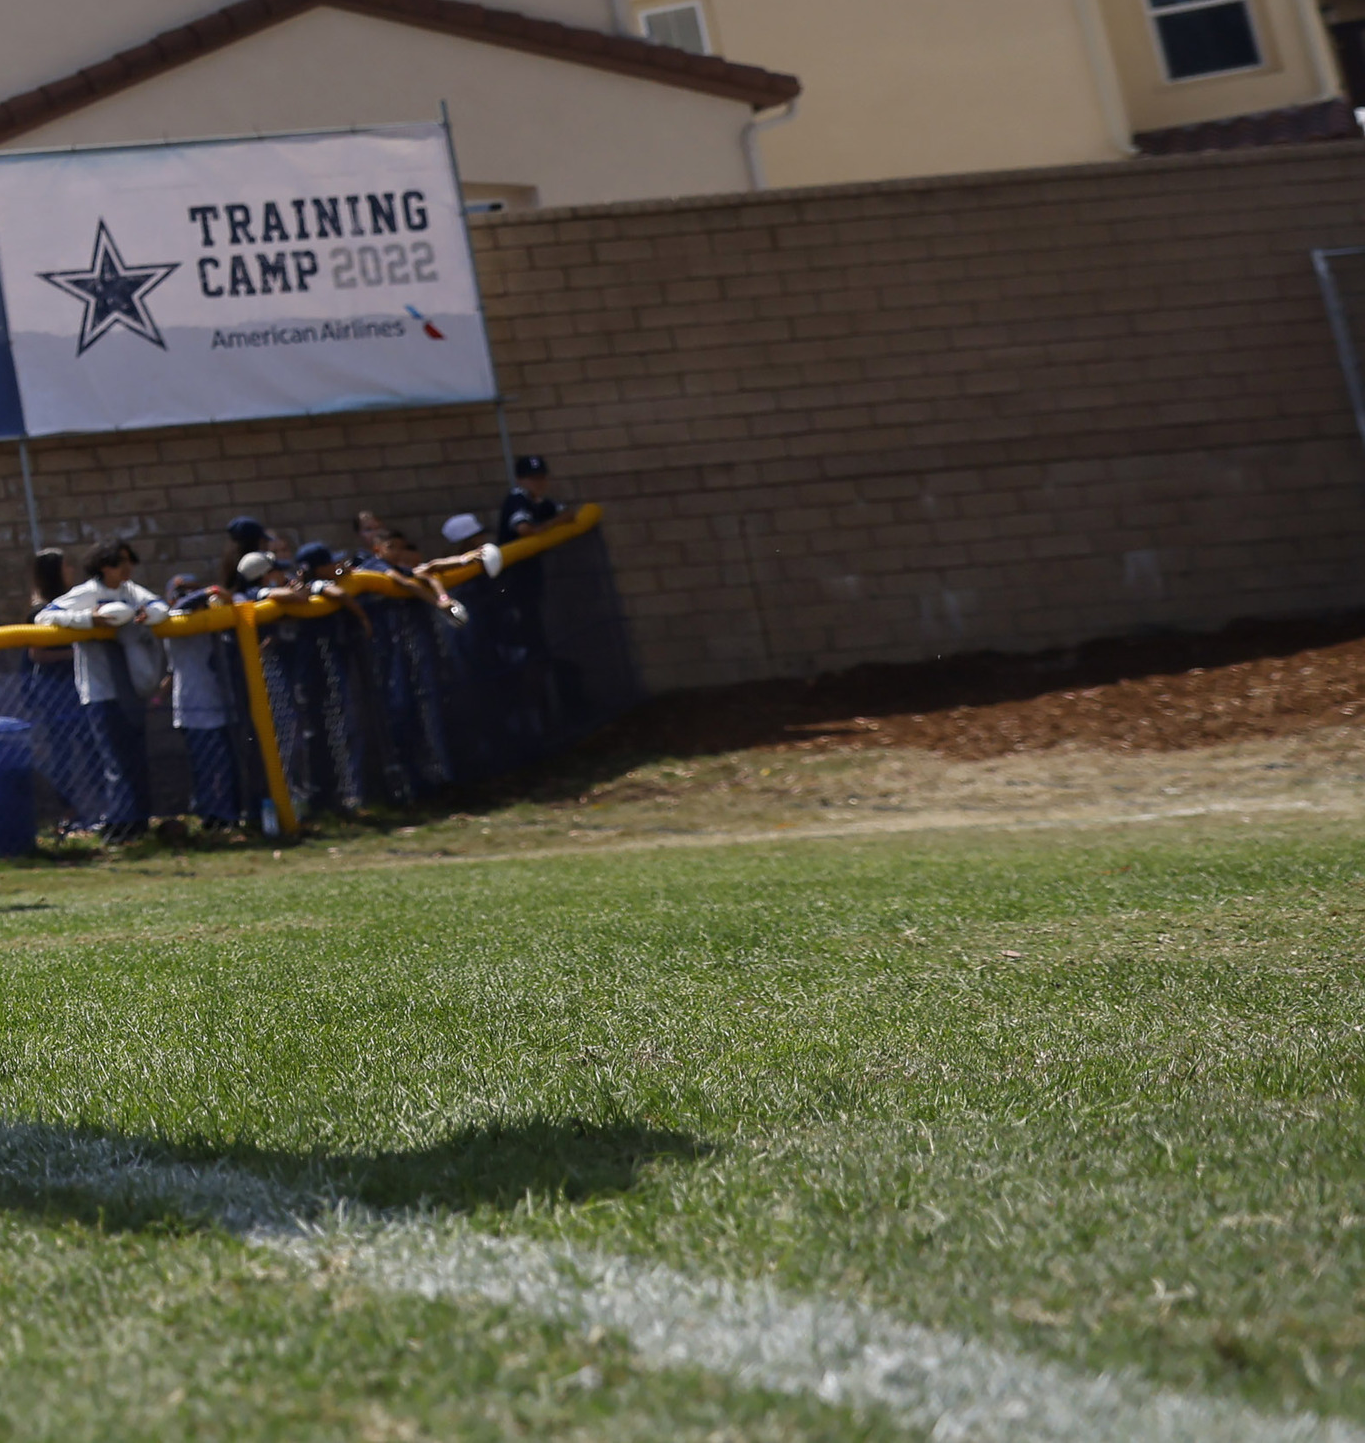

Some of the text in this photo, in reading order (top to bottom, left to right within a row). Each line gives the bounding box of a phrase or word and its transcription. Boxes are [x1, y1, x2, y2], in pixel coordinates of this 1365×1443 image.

[188, 191, 429, 247] TRAINING
[197, 241, 439, 298] CAMP 2022
[211, 318, 406, 350] American Airlines
